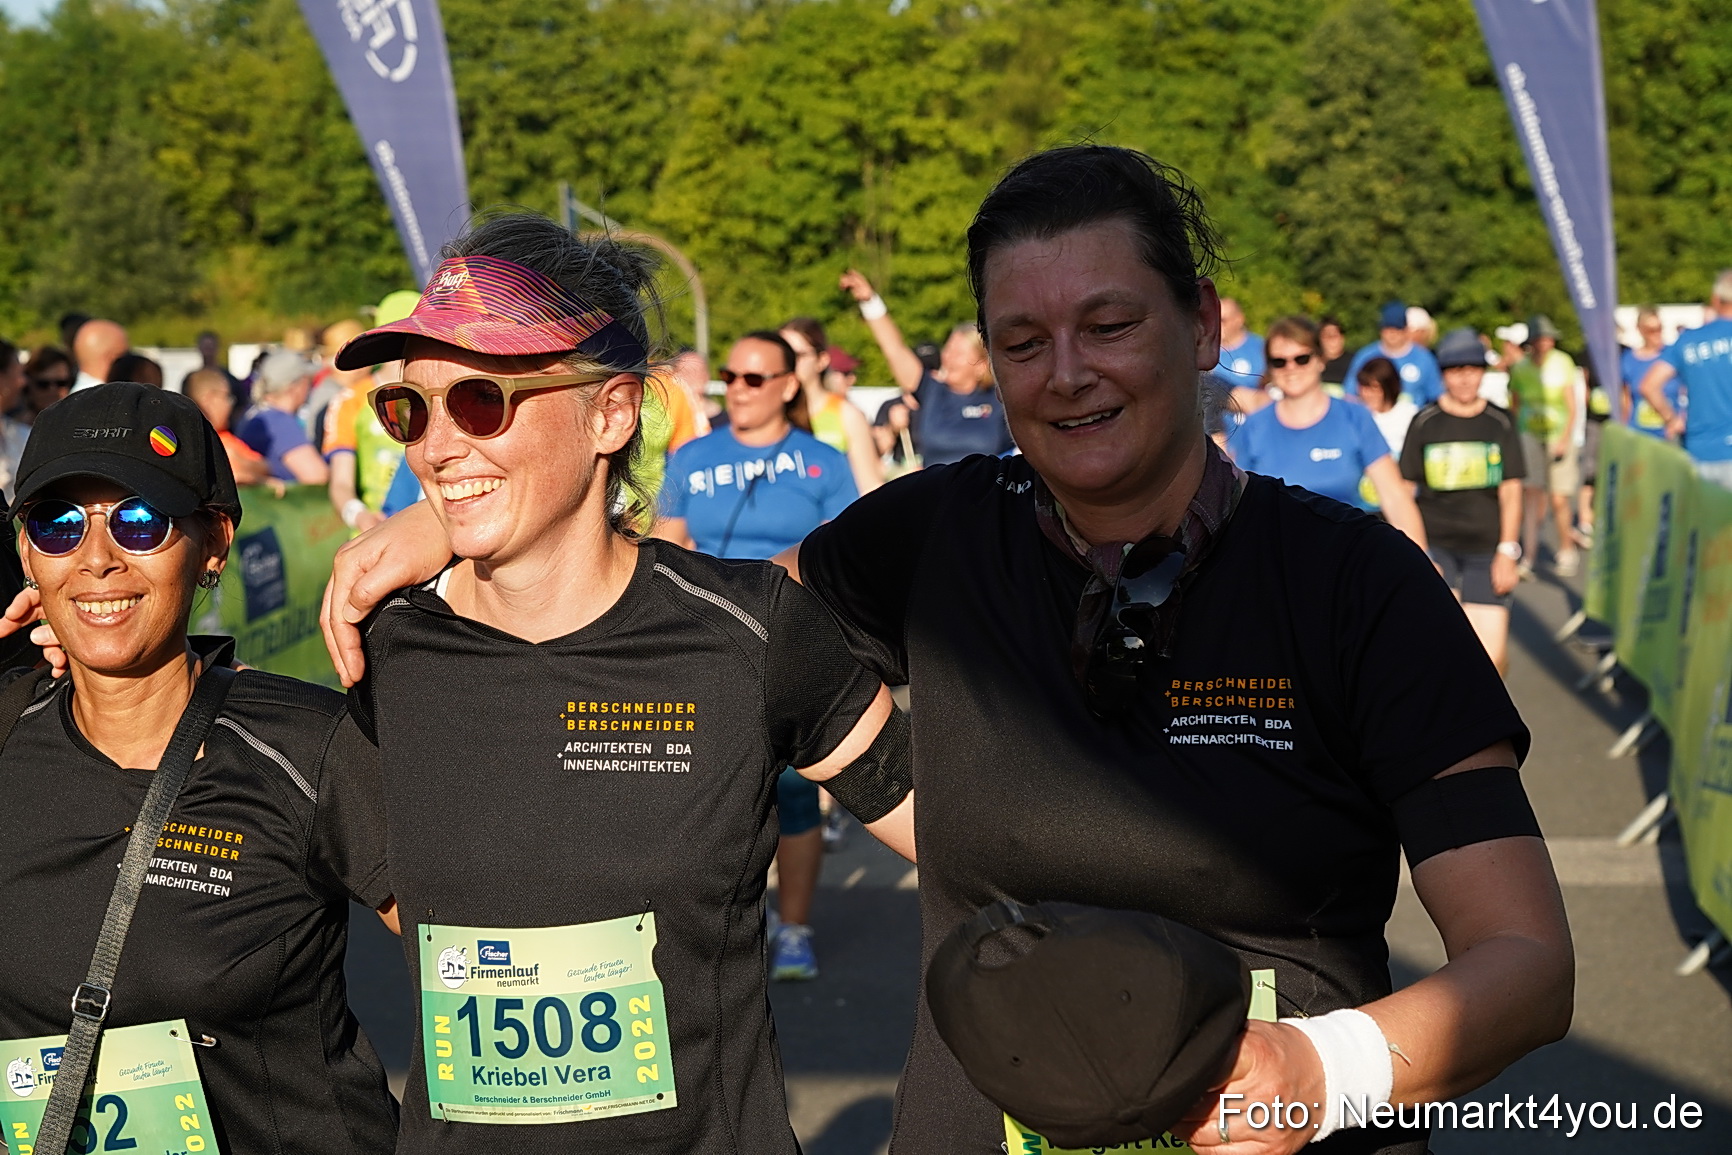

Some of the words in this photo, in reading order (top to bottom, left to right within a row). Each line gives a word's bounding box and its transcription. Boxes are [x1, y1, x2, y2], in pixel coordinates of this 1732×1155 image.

[73, 427, 132, 438] ESPRIT
[1172, 677, 1292, 691] BERSCHNEIDER
[567, 701, 696, 714] BERSCHNEIDER
[1171, 695, 1295, 709] BERSCHNEIDER
[567, 719, 695, 731] BERSCHNEIDER
[1171, 715, 1257, 727] ARCHITEKTEN
[1265, 719, 1292, 730] BDA
[564, 742, 652, 754] ARCHITEKTEN
[666, 744, 692, 755] BDA
[1170, 734, 1293, 750] INNENARCHITEKTEN
[563, 759, 690, 773] INNENARCHITEKTEN
[162, 822, 244, 845] SCHNEIDER
[157, 837, 240, 861] SCHNEIDER
[209, 867, 233, 881] BDA
[145, 873, 231, 898] NARCHITEKTEN
[470, 963, 539, 979] Firmenlauf
[567, 963, 598, 978] Gesunde
[599, 959, 624, 970] Firmen
[496, 977, 539, 988] neumarkt
[457, 991, 622, 1060] 1508
[628, 994, 659, 1084] 2022
[434, 1015, 455, 1081] RUN
[472, 1065, 548, 1087] Kriebel
[554, 1065, 611, 1085] Vera
[474, 1094, 521, 1104] Berschneider
[530, 1093, 584, 1104] Berschneider
[585, 1090, 611, 1100] GmbH
[174, 1093, 206, 1152] 022
